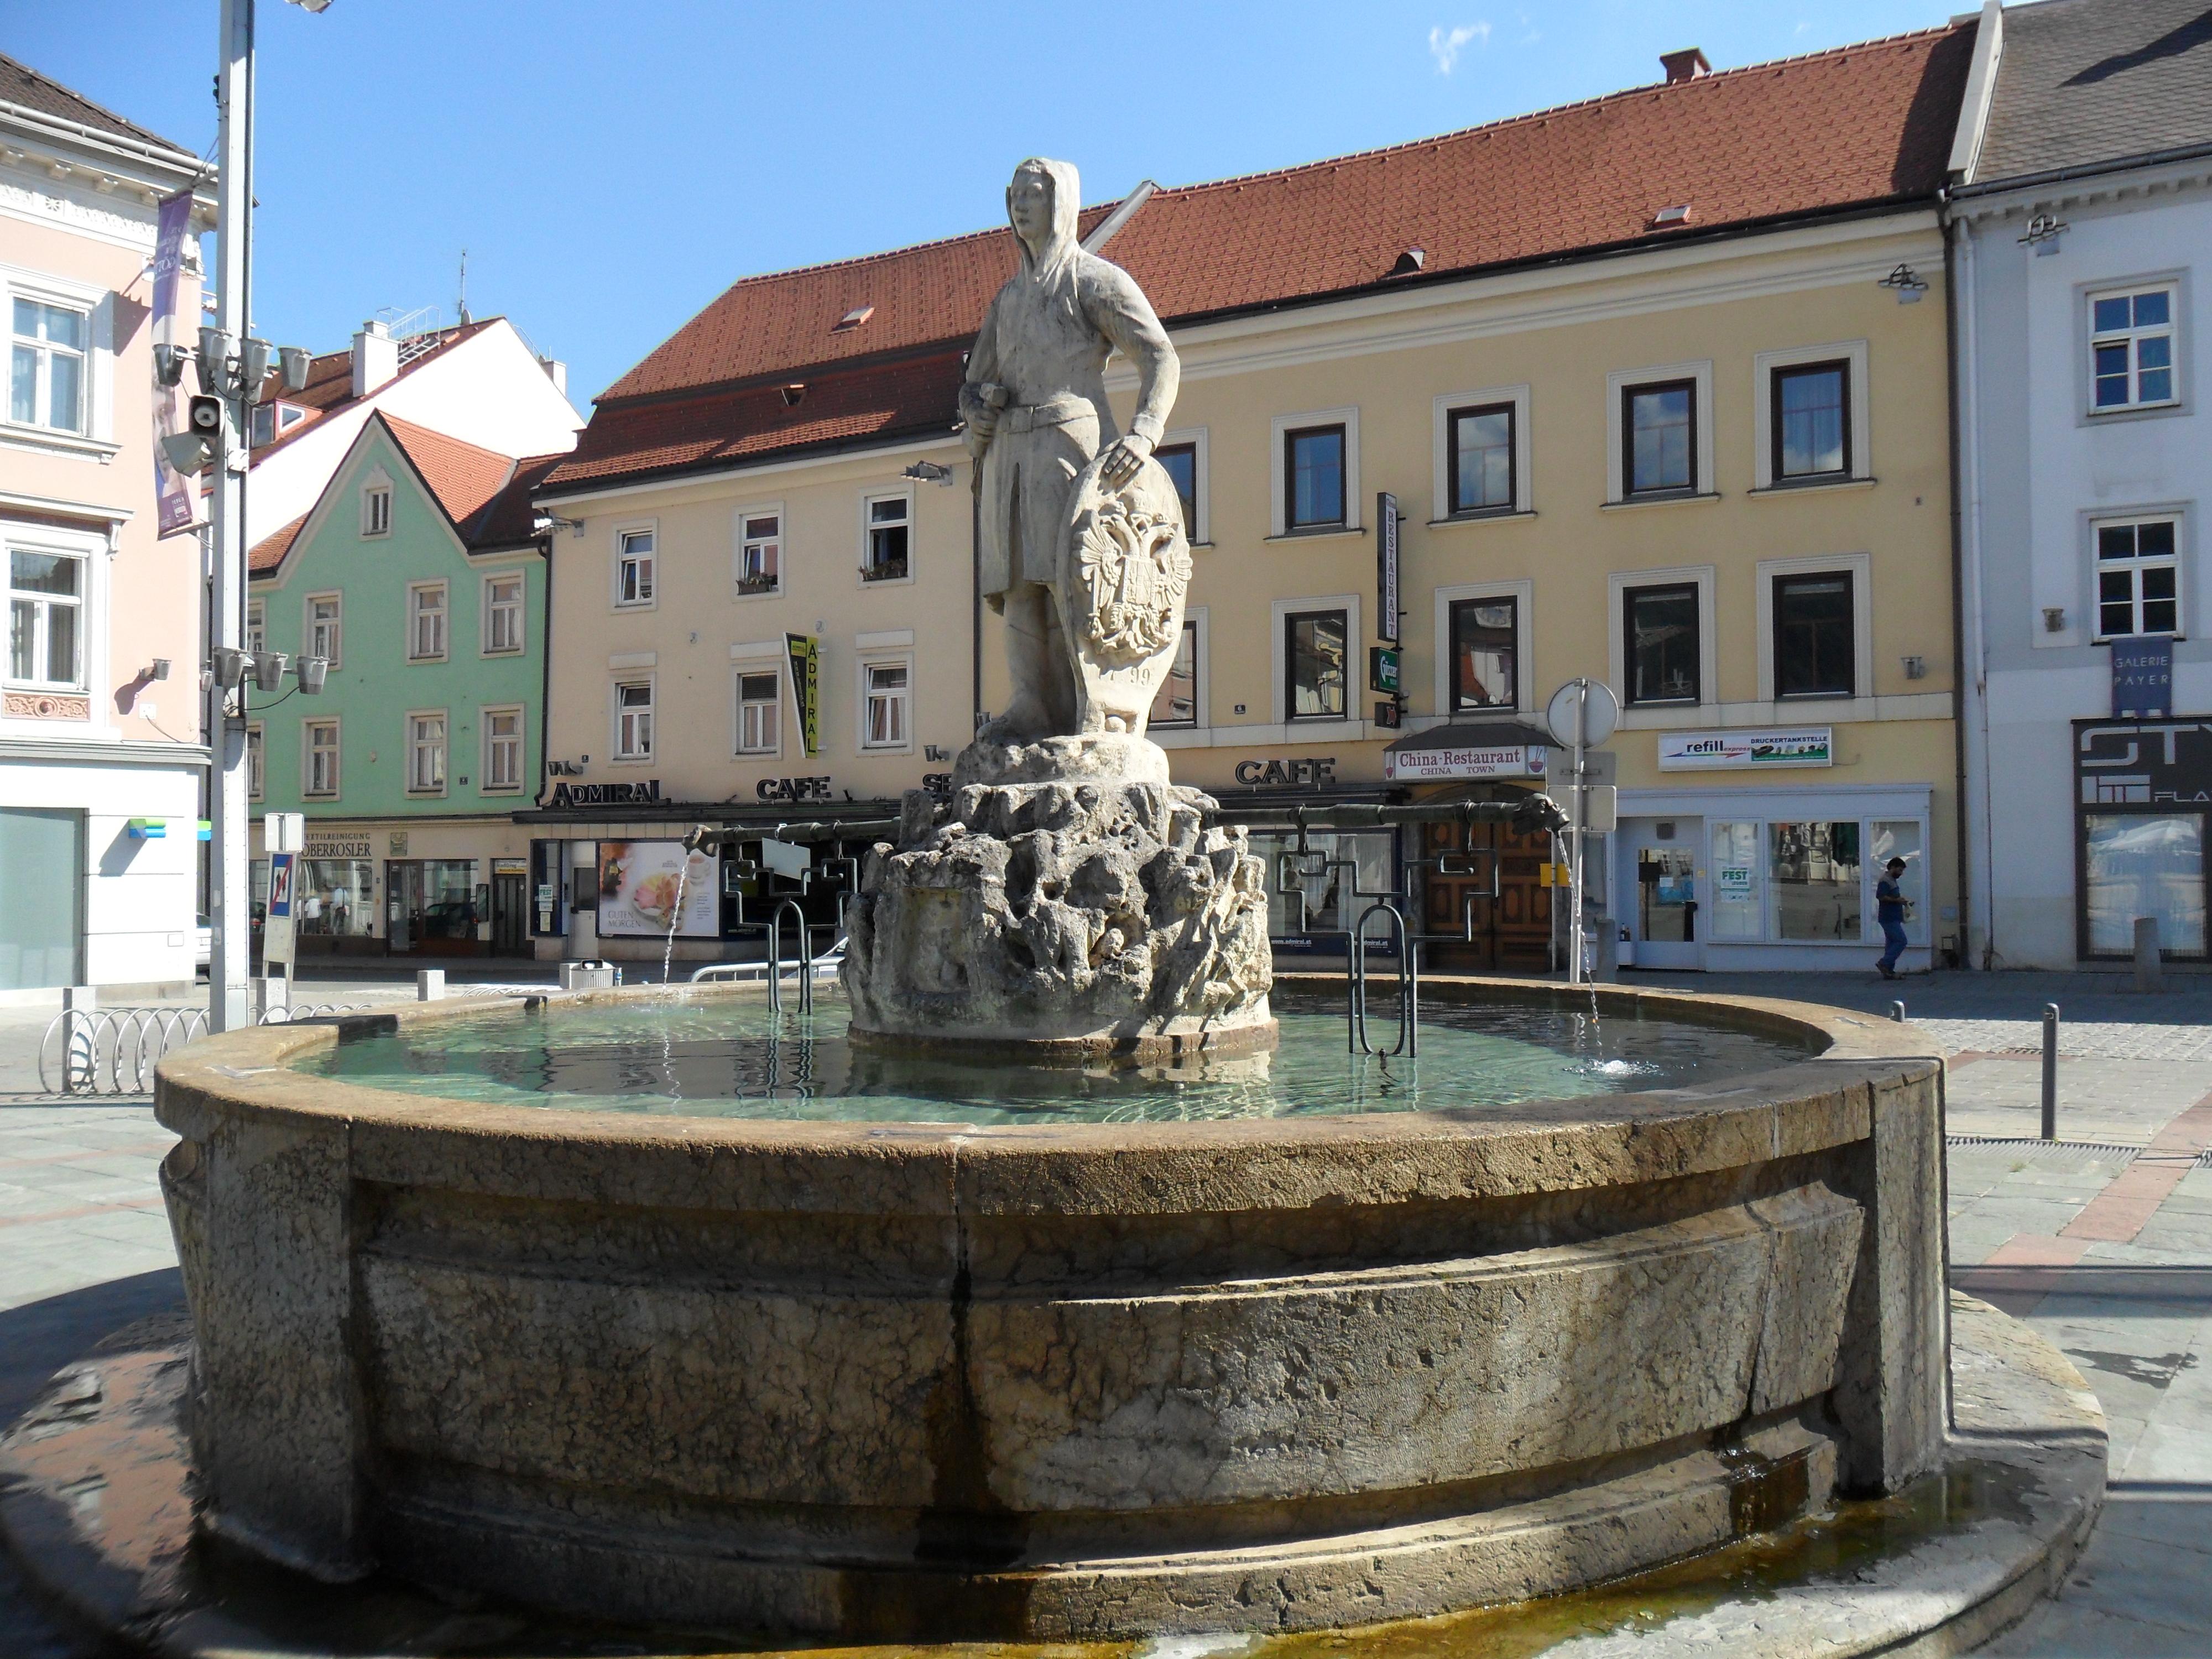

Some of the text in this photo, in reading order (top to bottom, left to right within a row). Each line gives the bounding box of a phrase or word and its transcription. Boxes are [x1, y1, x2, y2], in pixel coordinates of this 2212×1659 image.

[1387, 510, 1396, 636] RESTAURANT
[2115, 656, 2169, 668] GALERIE
[2114, 675, 2169, 686] PAYER
[807, 644, 817, 753] ADMIRAL
[1687, 740, 1724, 753] refill
[1750, 736, 1827, 744] DRUCKERTANKSTELLE
[1400, 748, 1520, 767] China-Restaurant
[1235, 757, 1336, 785] CAFE
[1420, 765, 1495, 775] CHINA TOWN
[552, 779, 671, 807] ADMIRAL
[756, 776, 832, 801] CAFE
[2154, 790, 2212, 803] FLA
[304, 832, 371, 841] EXTILREINIGUNG
[302, 842, 371, 857] OBERROSLER
[1722, 871, 1747, 880] FEST
[608, 911, 634, 919] GUTEN
[608, 919, 641, 927] MORGEN
